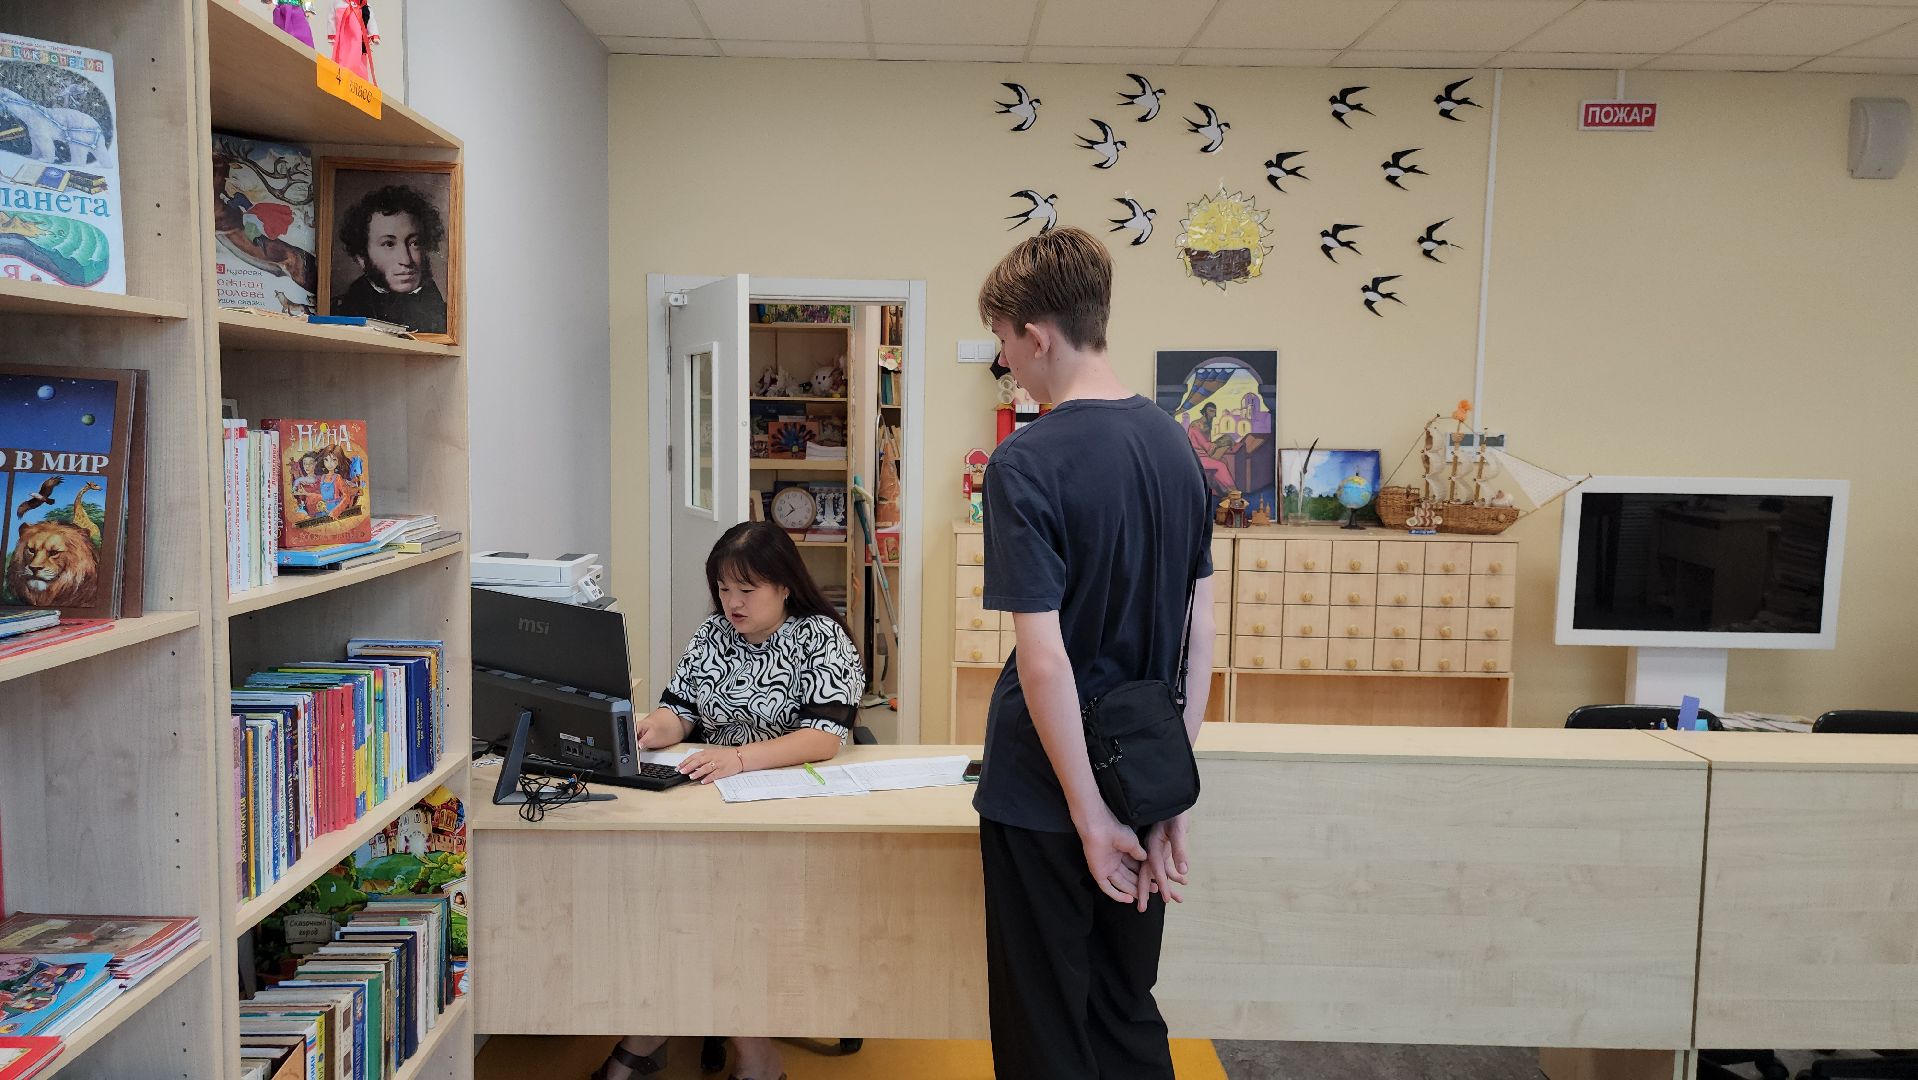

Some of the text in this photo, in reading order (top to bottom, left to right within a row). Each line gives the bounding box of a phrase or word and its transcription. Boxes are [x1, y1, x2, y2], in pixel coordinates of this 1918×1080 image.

[335, 67, 342, 86] 4
[1587, 106, 1653, 124] ПОЖАР
[295, 423, 353, 453] НИНА
[13, 450, 34, 470] В
[40, 452, 110, 474] МИР
[518, 617, 551, 636] msi
[240, 796, 248, 864] ХРЕСТОМАТИЯ
